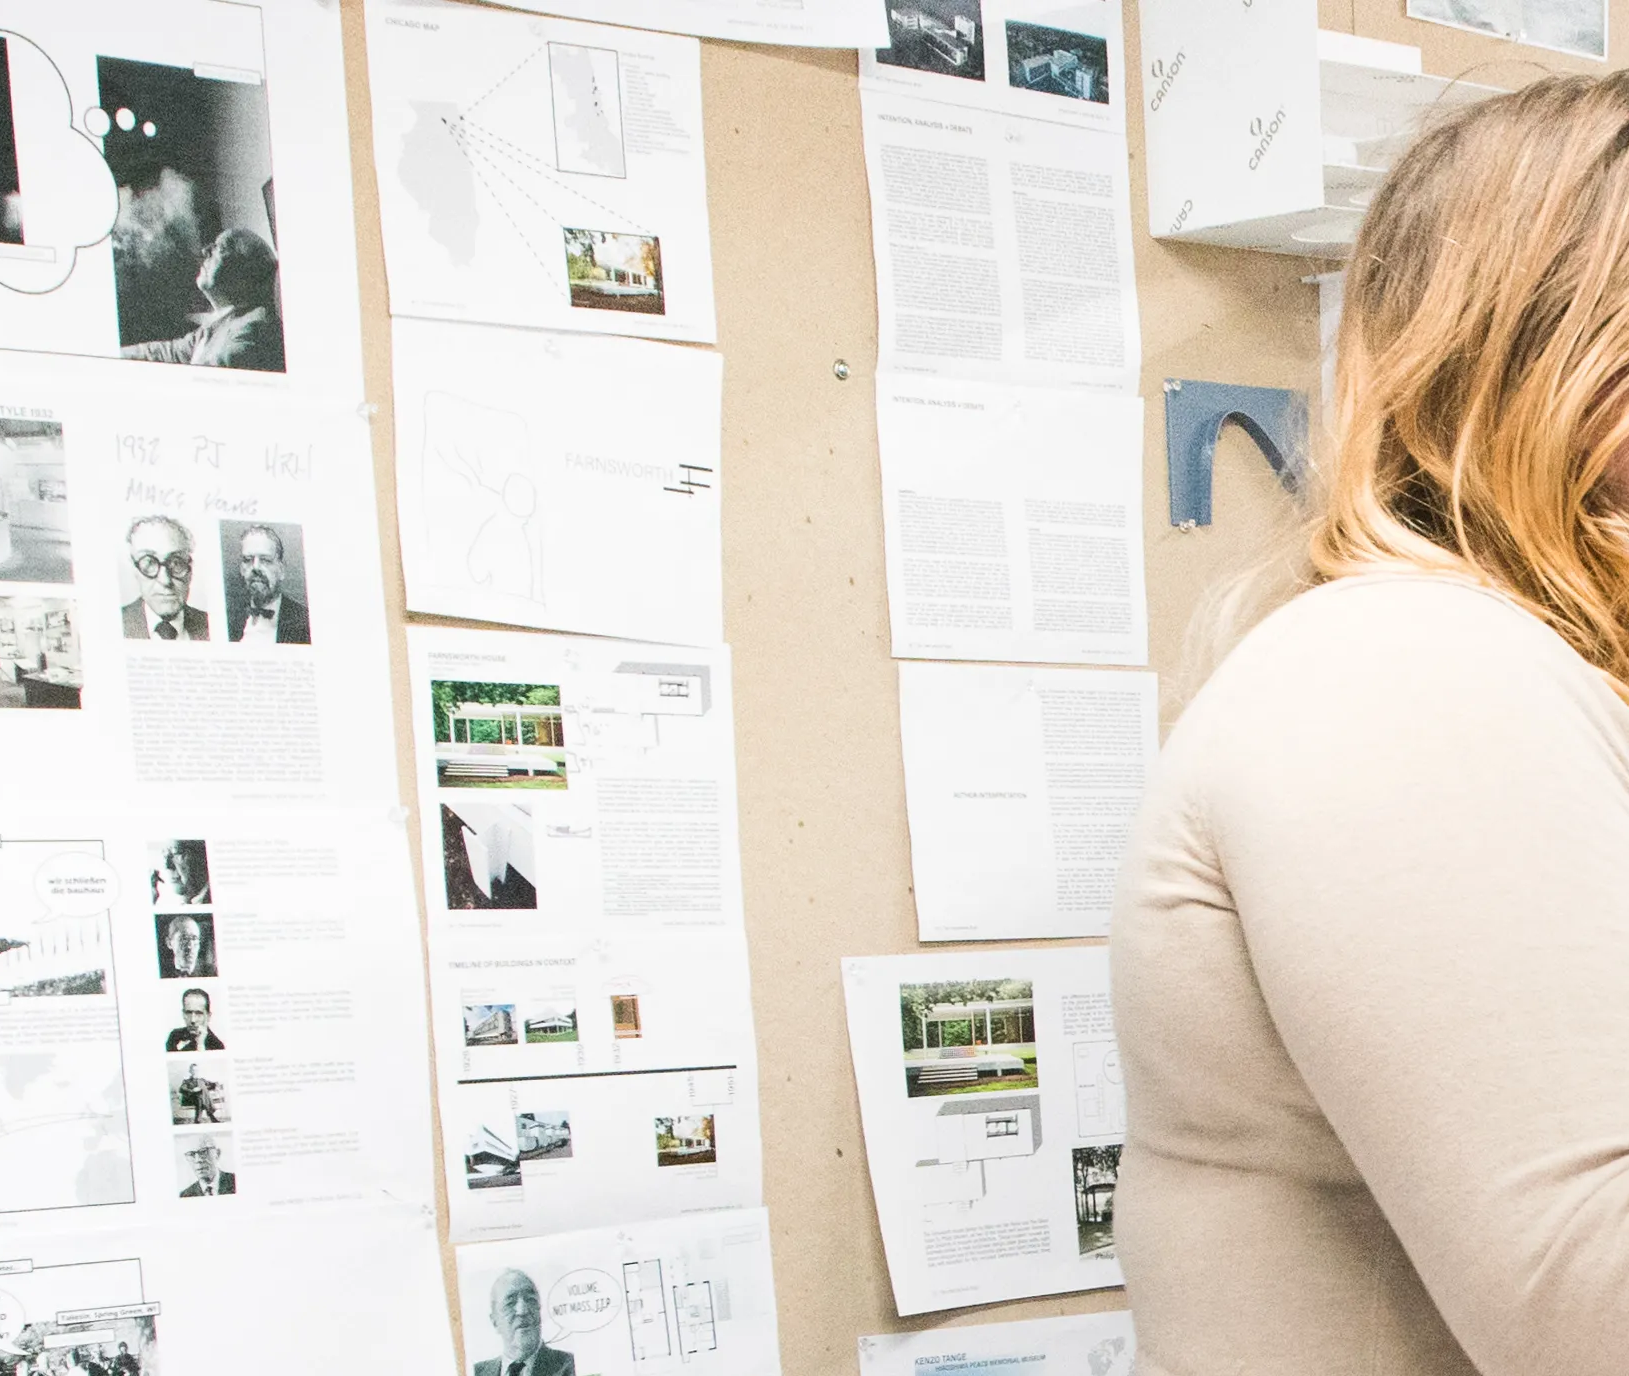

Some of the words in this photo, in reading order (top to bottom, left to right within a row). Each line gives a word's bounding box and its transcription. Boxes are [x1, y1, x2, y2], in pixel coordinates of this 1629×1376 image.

[384, 16, 422, 30] CHICAGO
[424, 21, 440, 32] MAP
[565, 452, 673, 483] FARNSWORTH
[553, 1302, 569, 1316] NOT
[915, 1355, 940, 1366] KENZO
[942, 1352, 967, 1363] TANGE
